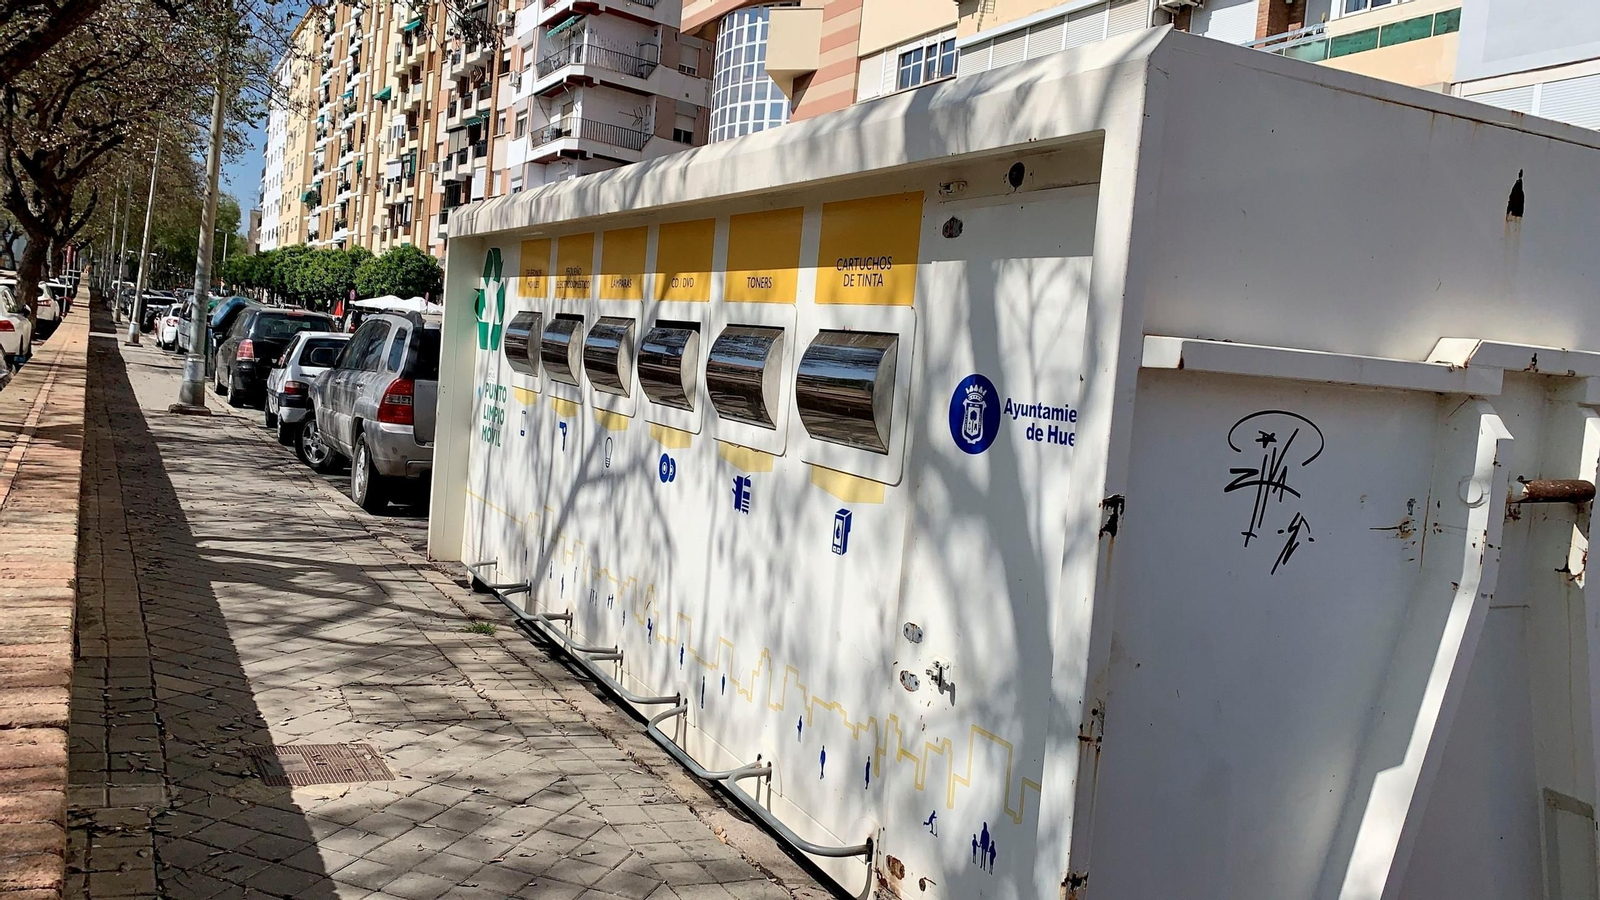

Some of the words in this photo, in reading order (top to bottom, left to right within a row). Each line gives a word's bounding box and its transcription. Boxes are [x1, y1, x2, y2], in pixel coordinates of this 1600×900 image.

[836, 256, 893, 271] CARTUCHOS
[671, 277, 679, 288] CD
[683, 277, 695, 288] DVD
[747, 276, 773, 289] TONERS
[843, 274, 854, 287] DE
[857, 273, 884, 287] TINTA
[485, 382, 507, 403] PUNTO
[483, 404, 505, 425] LIMPIO
[1004, 398, 1077, 422] Ayuntamie
[481, 422, 501, 447] MÓVIL
[1026, 423, 1043, 441] de
